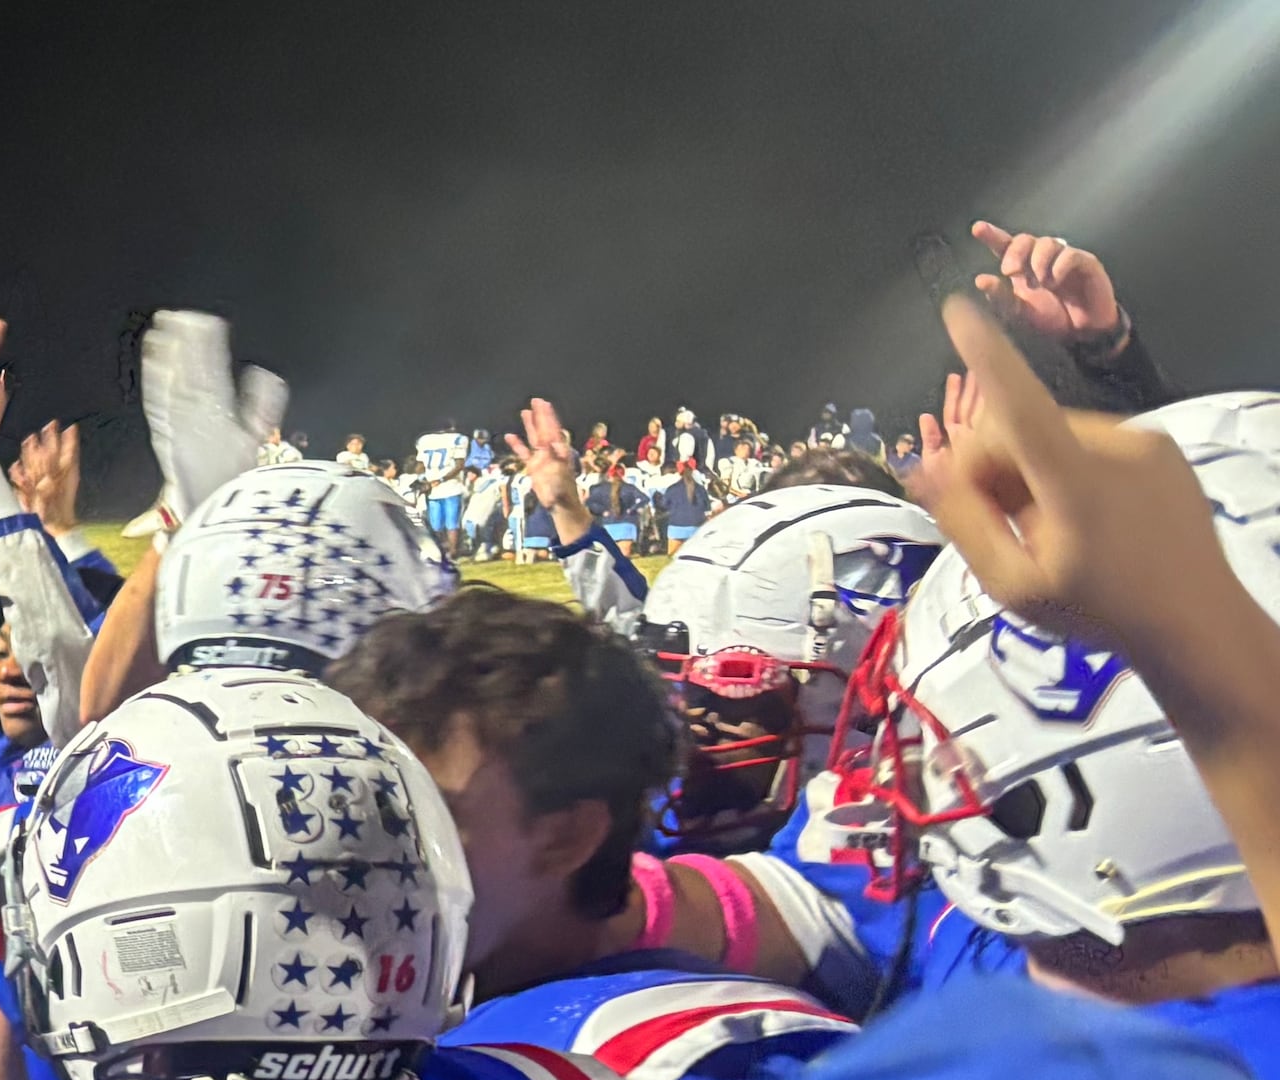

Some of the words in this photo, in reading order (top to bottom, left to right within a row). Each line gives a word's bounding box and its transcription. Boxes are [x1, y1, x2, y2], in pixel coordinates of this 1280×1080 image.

[423, 447, 448, 471] 77
[256, 573, 293, 600] 75
[376, 953, 416, 994] 16
[253, 1044, 401, 1080] schutt
